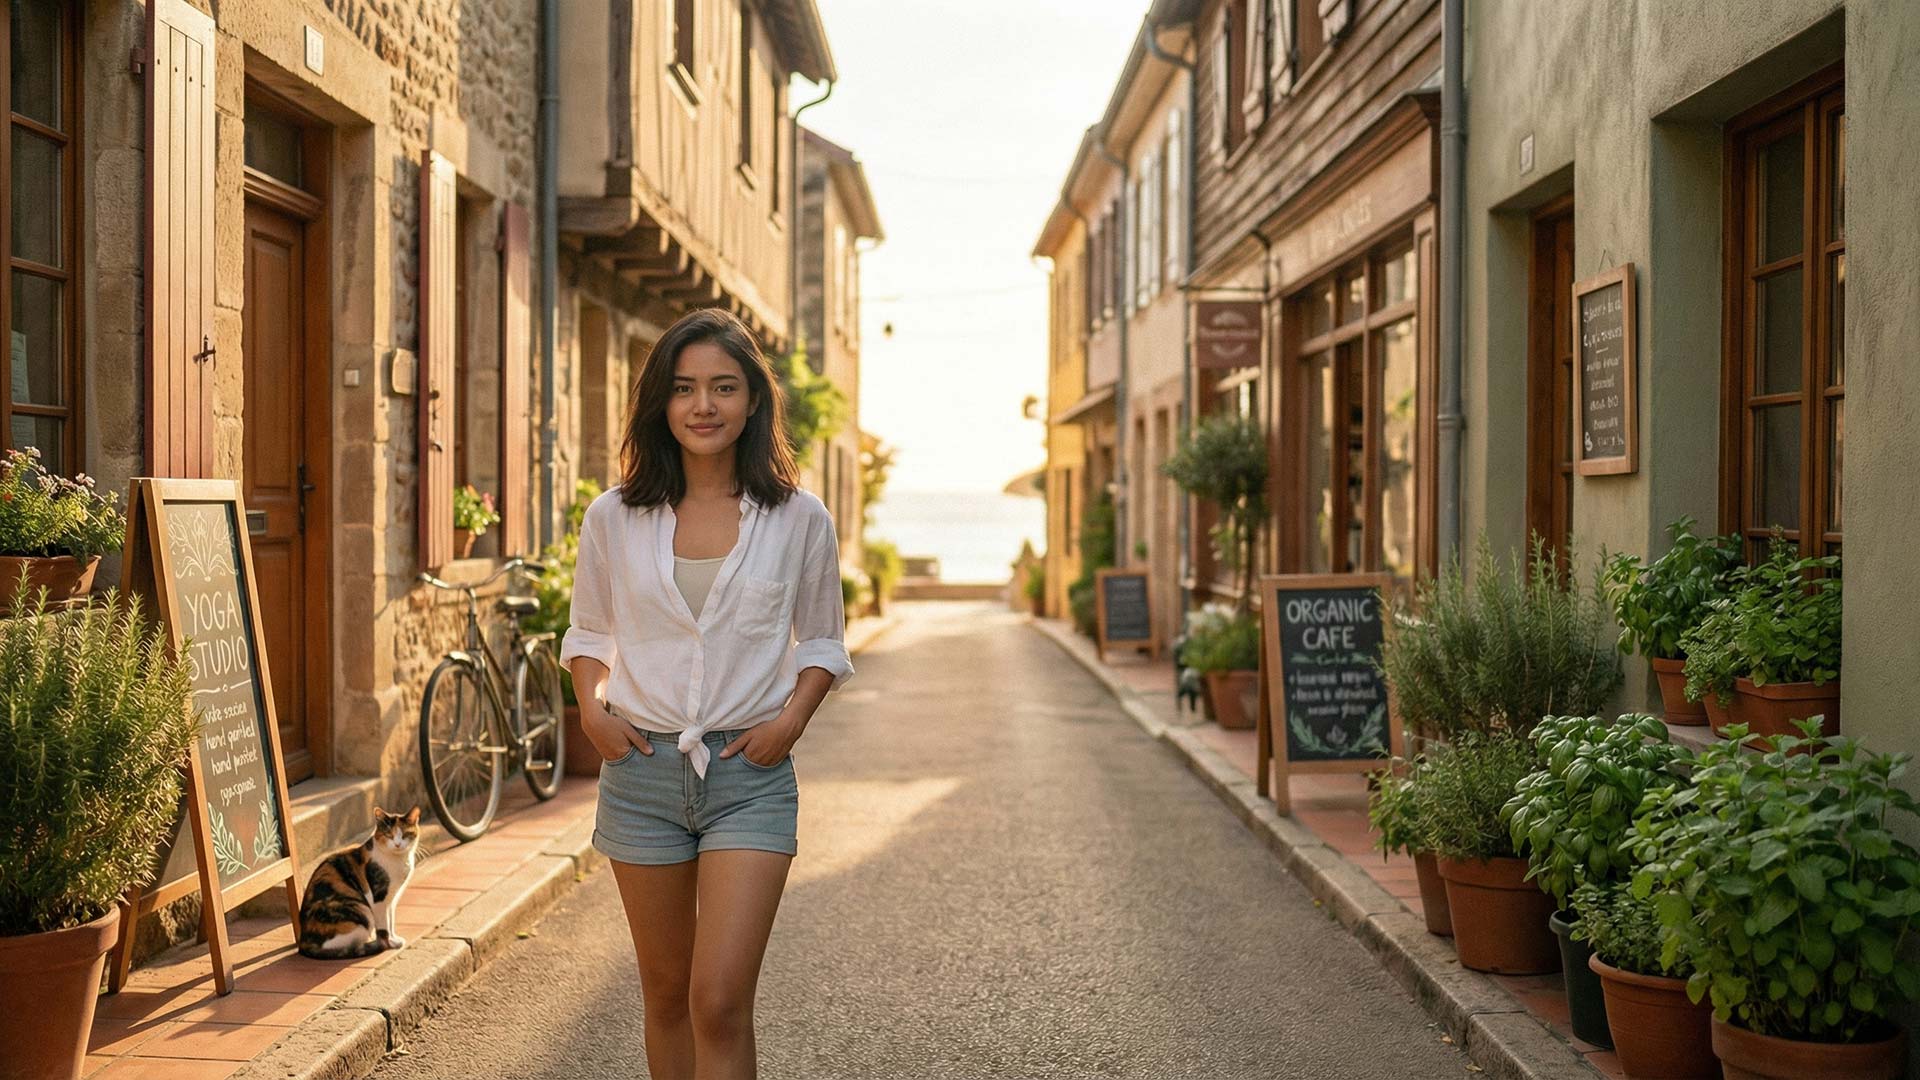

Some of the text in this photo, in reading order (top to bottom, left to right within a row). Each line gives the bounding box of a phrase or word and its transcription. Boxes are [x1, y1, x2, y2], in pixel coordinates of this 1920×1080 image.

[184, 591, 240, 636] YOGA
[1286, 598, 1374, 624] ORGANIC
[1302, 625, 1356, 650] CAFE
